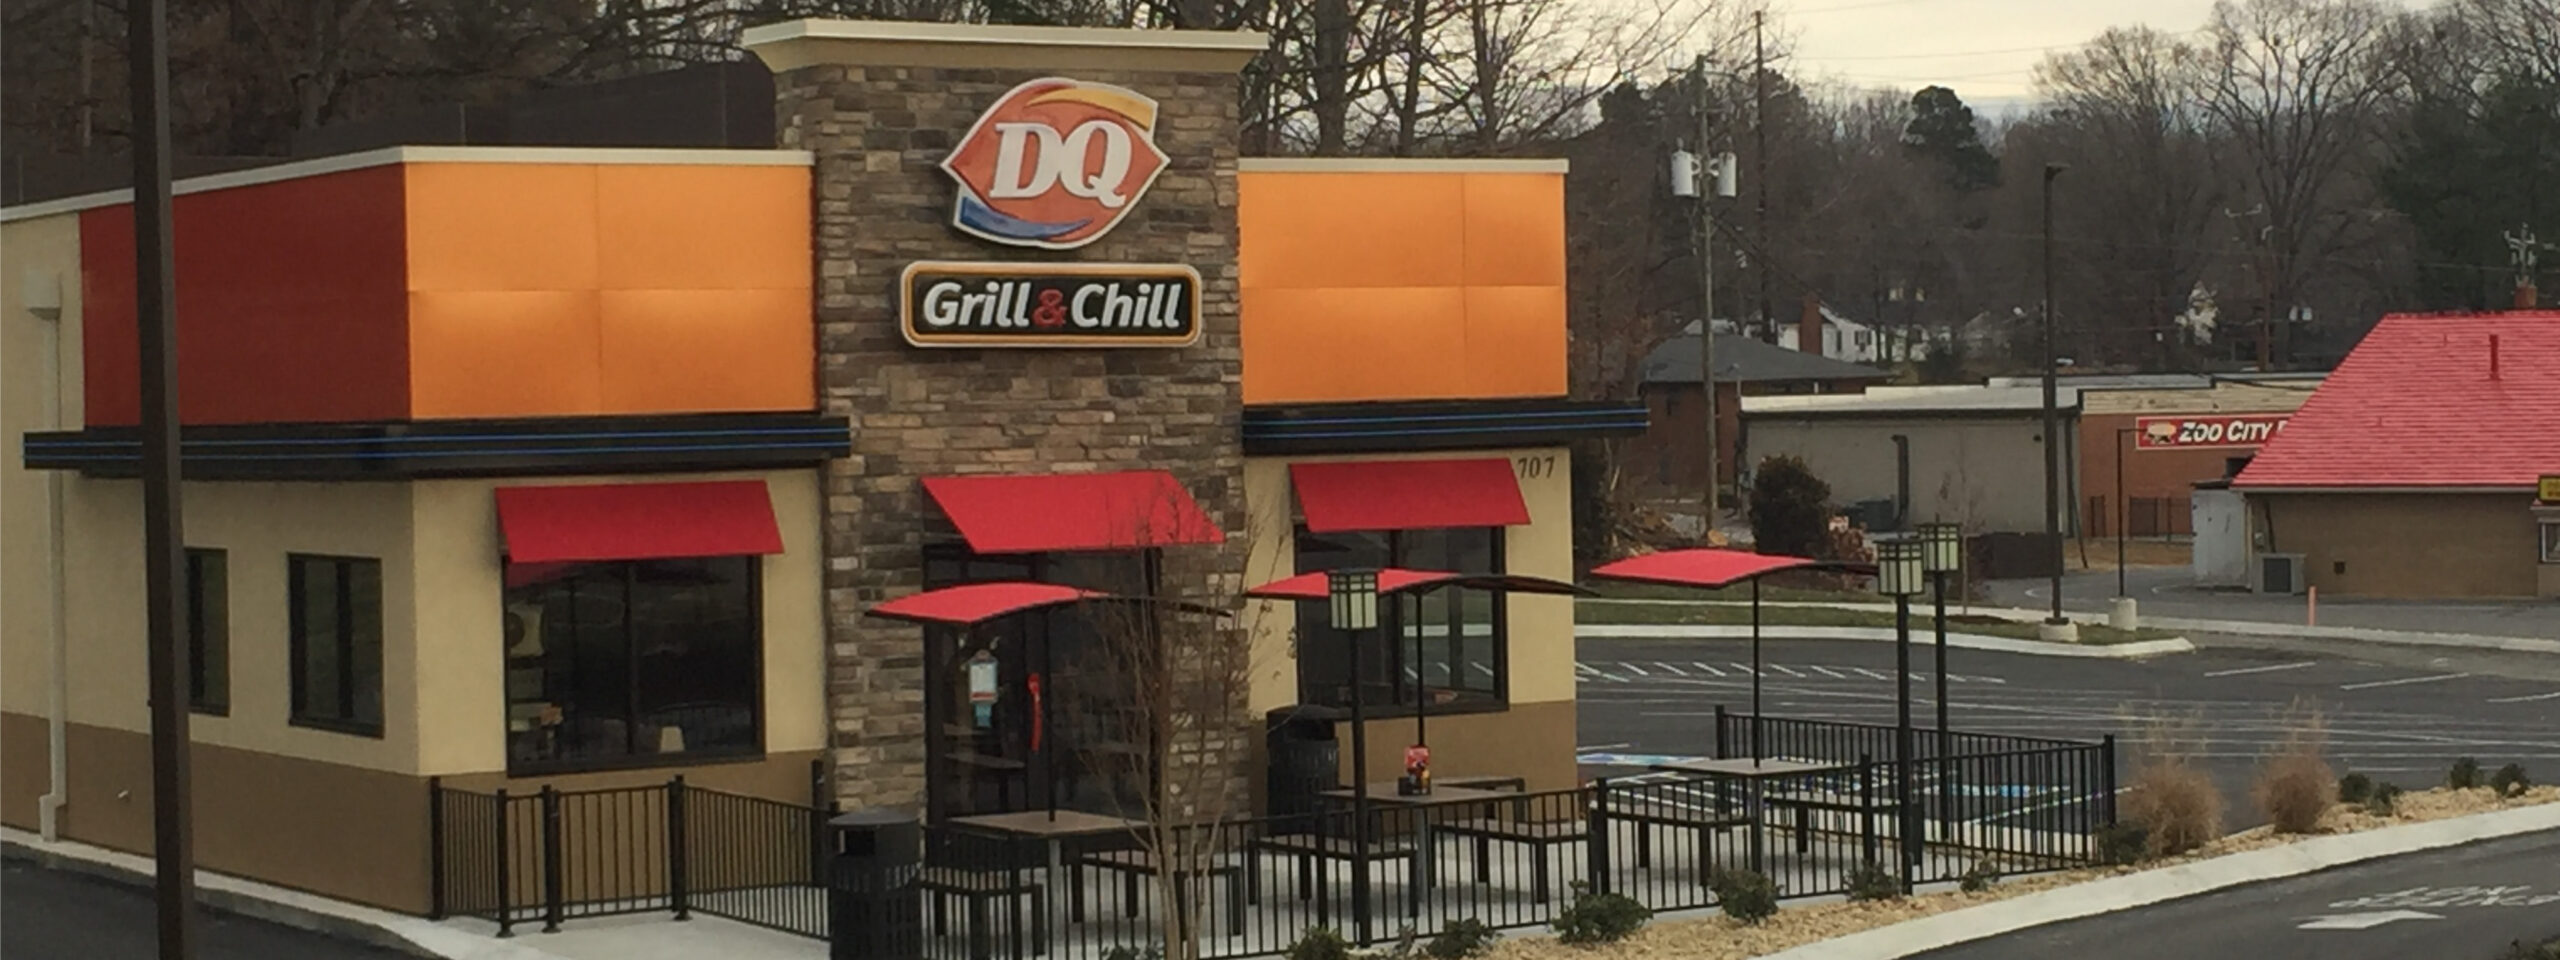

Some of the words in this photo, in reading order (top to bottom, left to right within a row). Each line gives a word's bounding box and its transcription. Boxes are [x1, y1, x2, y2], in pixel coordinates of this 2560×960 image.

[989, 119, 1132, 207] DQ
[2178, 421, 2223, 443] ZOO
[2226, 420, 2273, 442] CITY
[1518, 455, 1555, 479] 707
